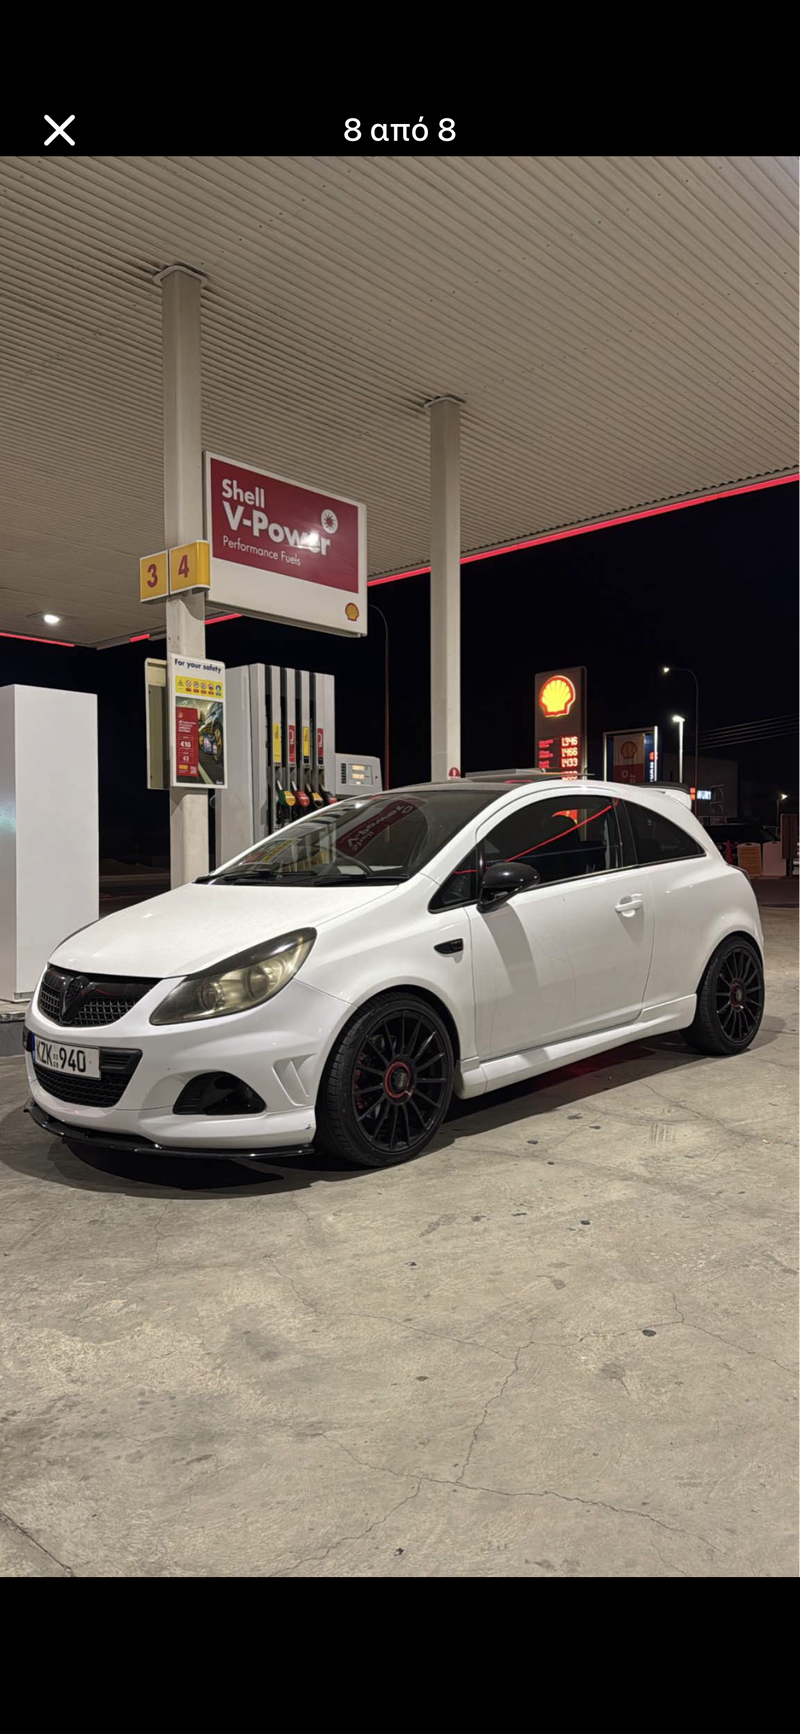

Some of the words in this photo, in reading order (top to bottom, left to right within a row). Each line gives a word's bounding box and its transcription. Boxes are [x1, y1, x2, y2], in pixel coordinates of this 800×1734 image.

[222, 478, 265, 508] Shell
[222, 500, 331, 556] V-Power
[223, 535, 279, 560] Performance
[281, 551, 301, 566] Fuels
[147, 563, 158, 588] 3
[178, 554, 190, 578] 4
[174, 658, 185, 666] For
[186, 661, 202, 669] your
[203, 663, 222, 674] safety
[36, 1039, 53, 1067] KZK
[59, 1046, 86, 1073] 940
